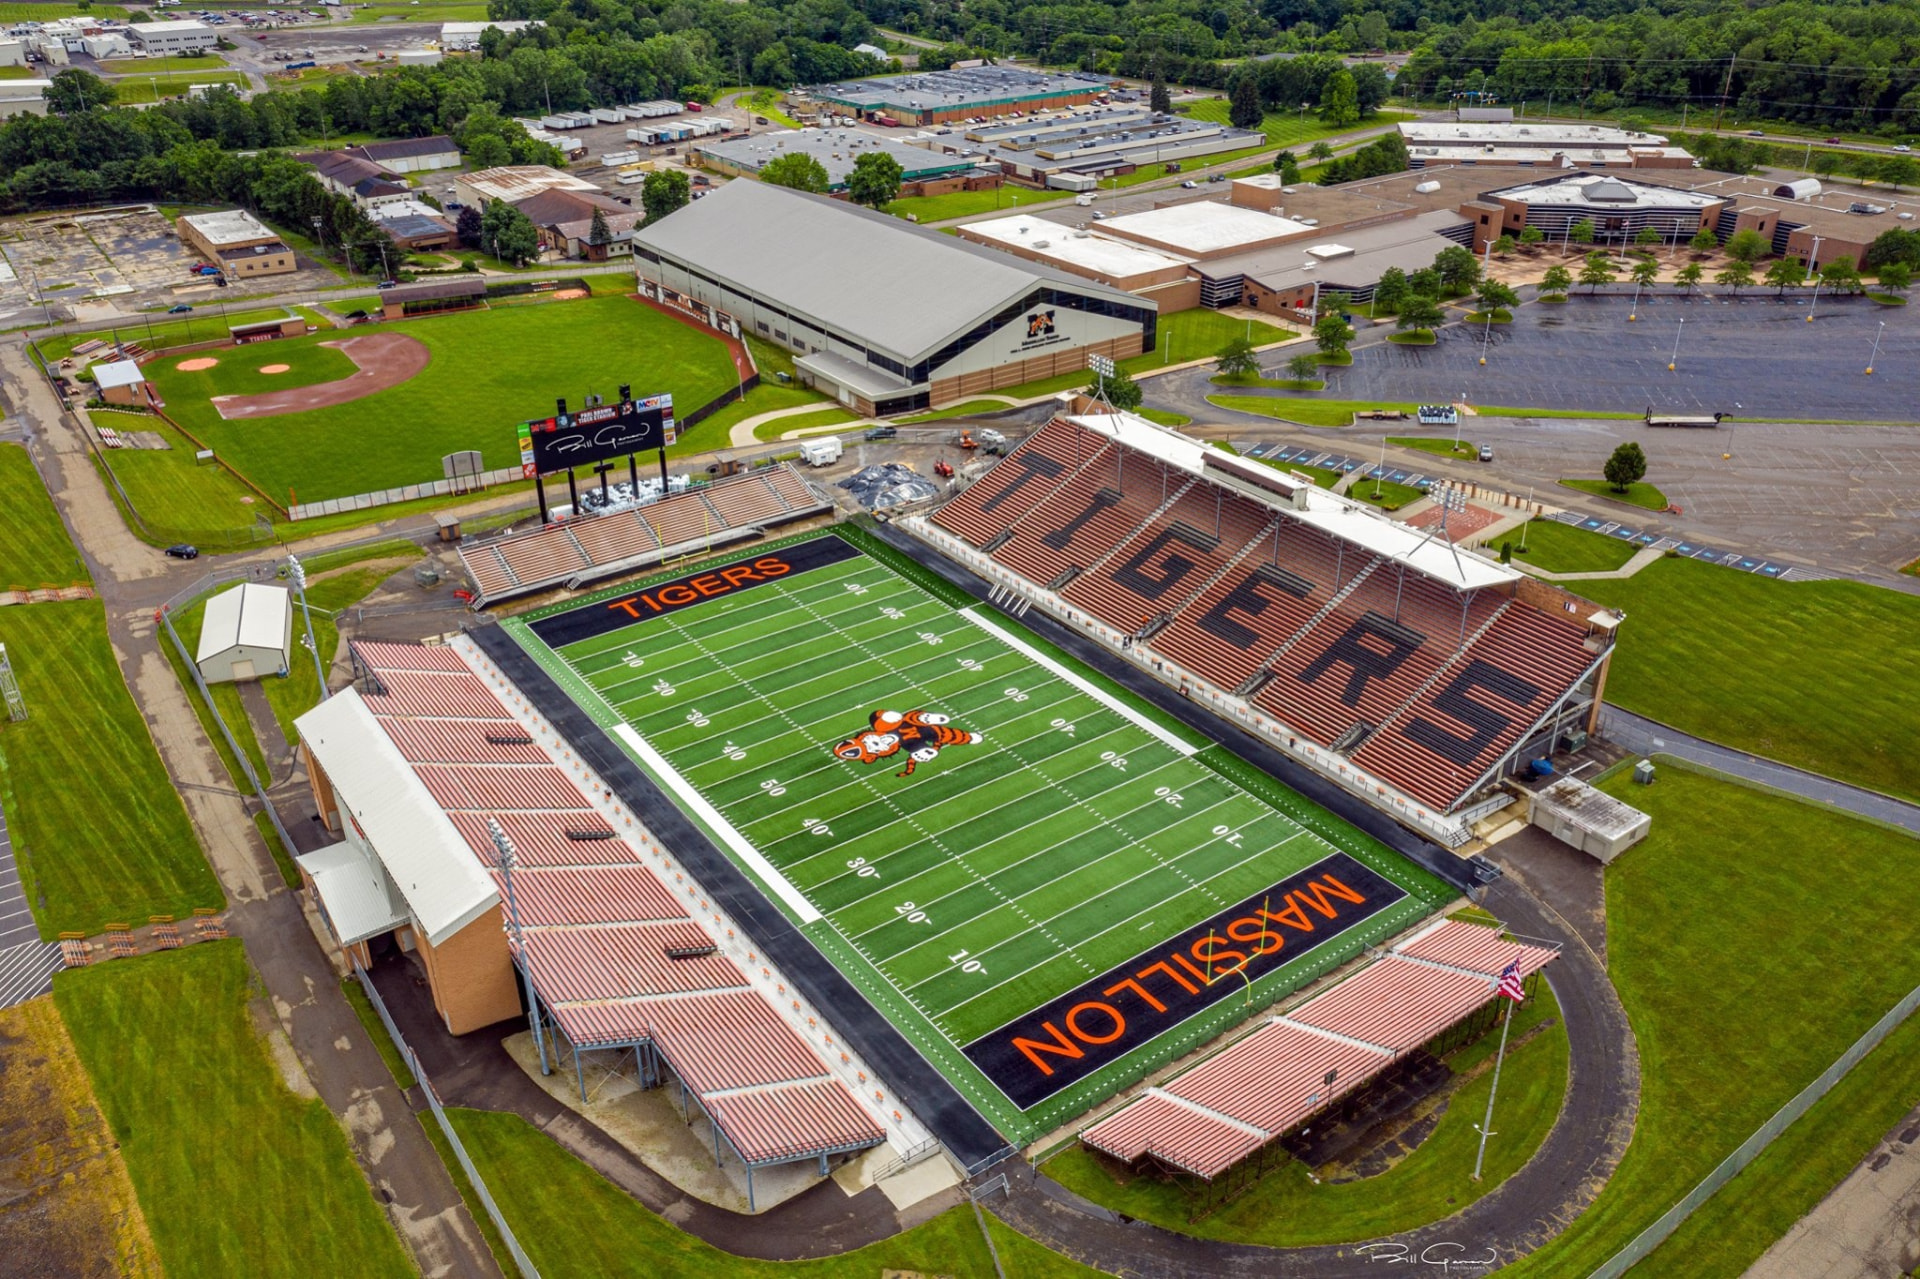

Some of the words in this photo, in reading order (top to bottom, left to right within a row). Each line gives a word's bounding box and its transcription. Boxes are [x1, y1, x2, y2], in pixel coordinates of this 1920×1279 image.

[545, 435, 592, 454] Bill
[608, 557, 791, 618] TIGERS
[846, 583, 869, 596] 10
[882, 607, 906, 620] 20
[980, 449, 1542, 767] TIGERS
[919, 632, 943, 645] 30
[622, 653, 645, 668] 10
[959, 658, 984, 672] 40
[652, 682, 676, 697] 20
[1004, 687, 1029, 702] 50
[686, 710, 710, 727] 30
[1050, 718, 1076, 734] 40
[722, 744, 747, 761] 40
[1100, 751, 1128, 768] 30
[760, 778, 787, 797] 50
[1154, 786, 1184, 804] 20
[801, 818, 829, 836] 40
[1211, 824, 1244, 844] 10
[846, 857, 876, 877] 30
[894, 901, 926, 923] 20
[948, 949, 981, 973] 10
[1011, 874, 1366, 1076] MASSILLON
